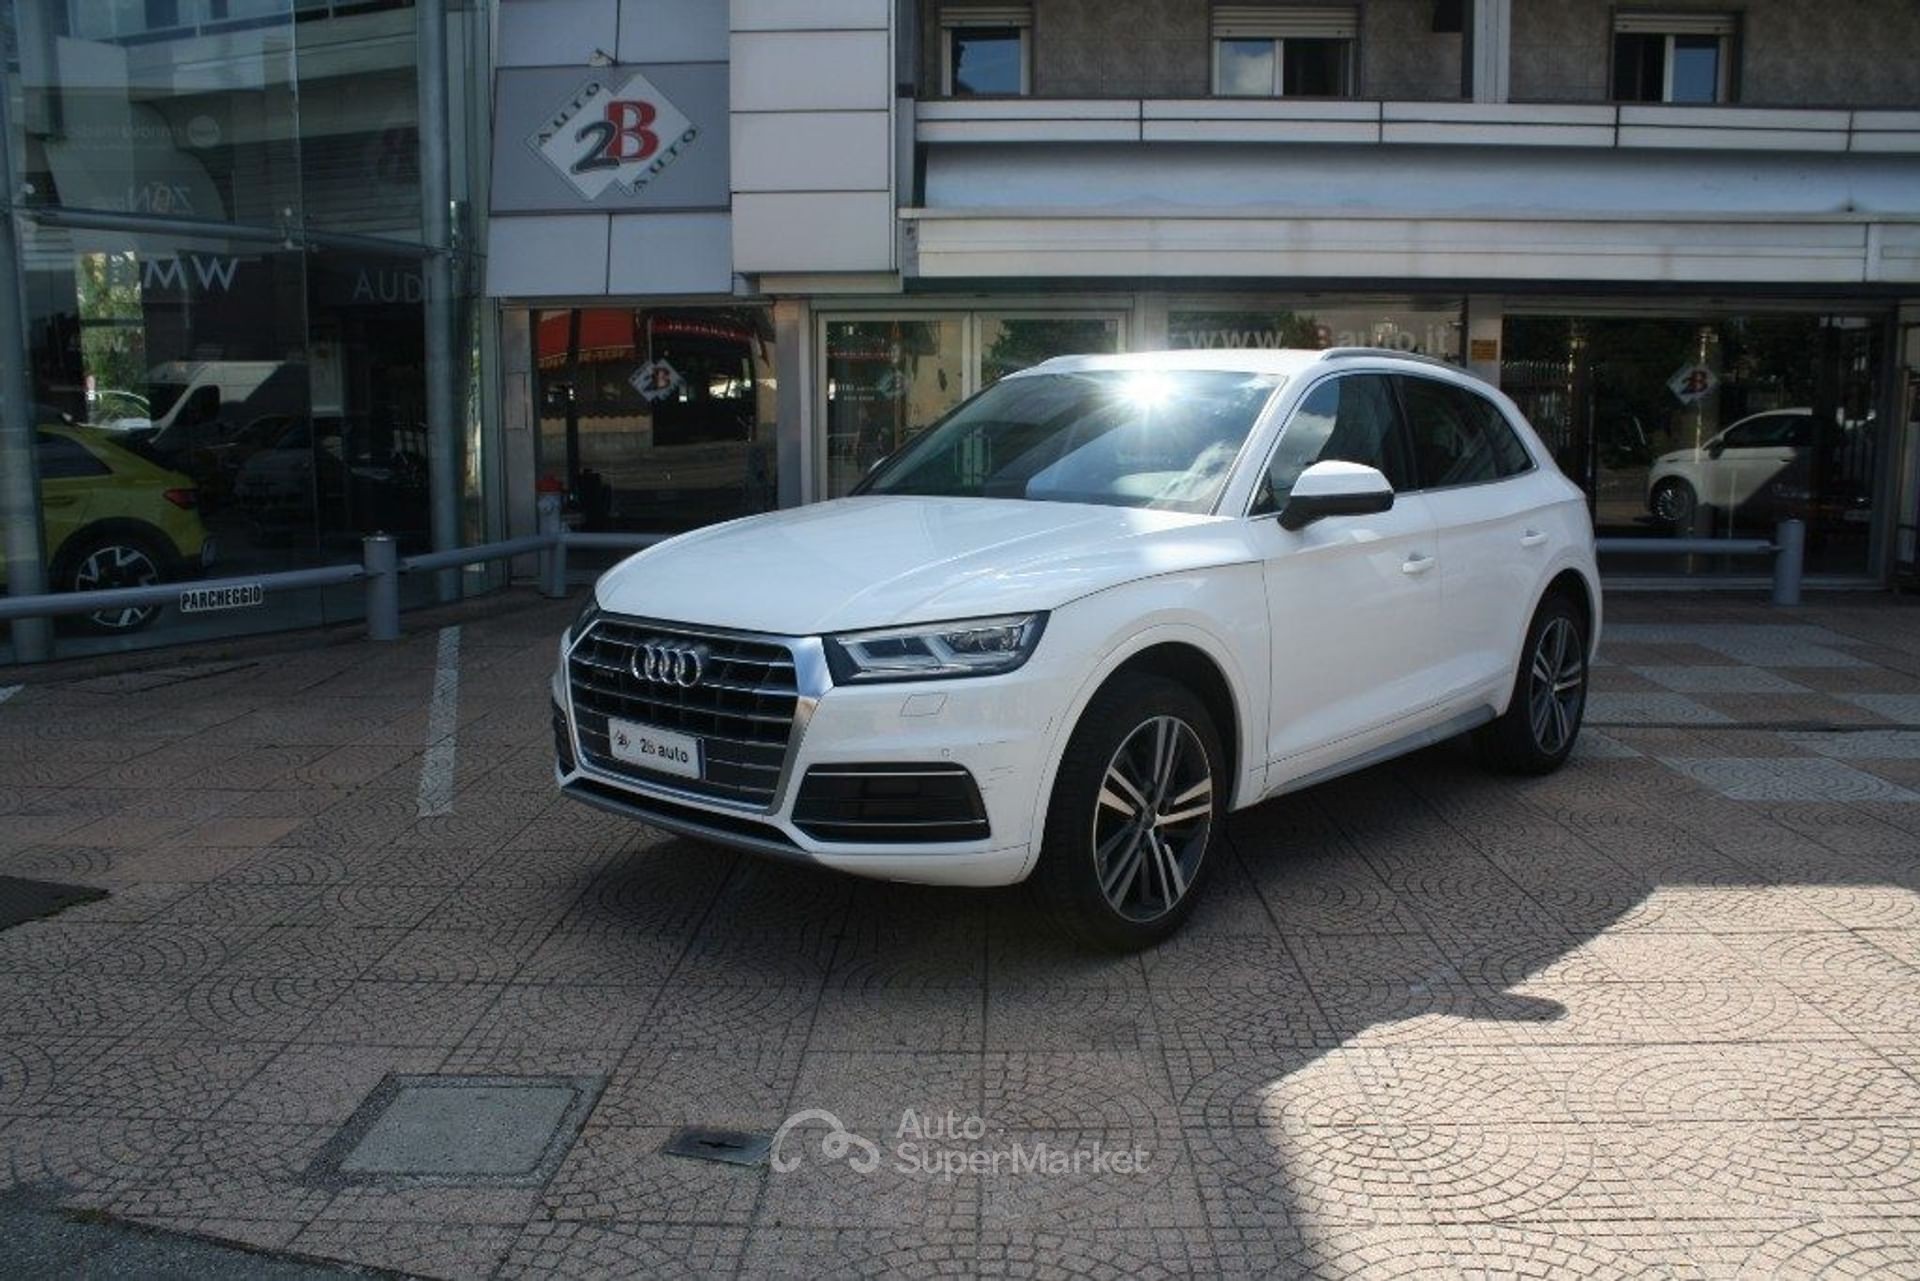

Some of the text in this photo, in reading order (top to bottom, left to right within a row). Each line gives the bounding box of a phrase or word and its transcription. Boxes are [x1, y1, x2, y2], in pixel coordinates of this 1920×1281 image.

[537, 82, 600, 147] AUTO
[571, 98, 660, 176] 2B
[633, 128, 697, 193] AUTO
[143, 254, 239, 292] MW
[182, 585, 261, 610] PARCHEGGIO
[658, 745, 689, 763] auto
